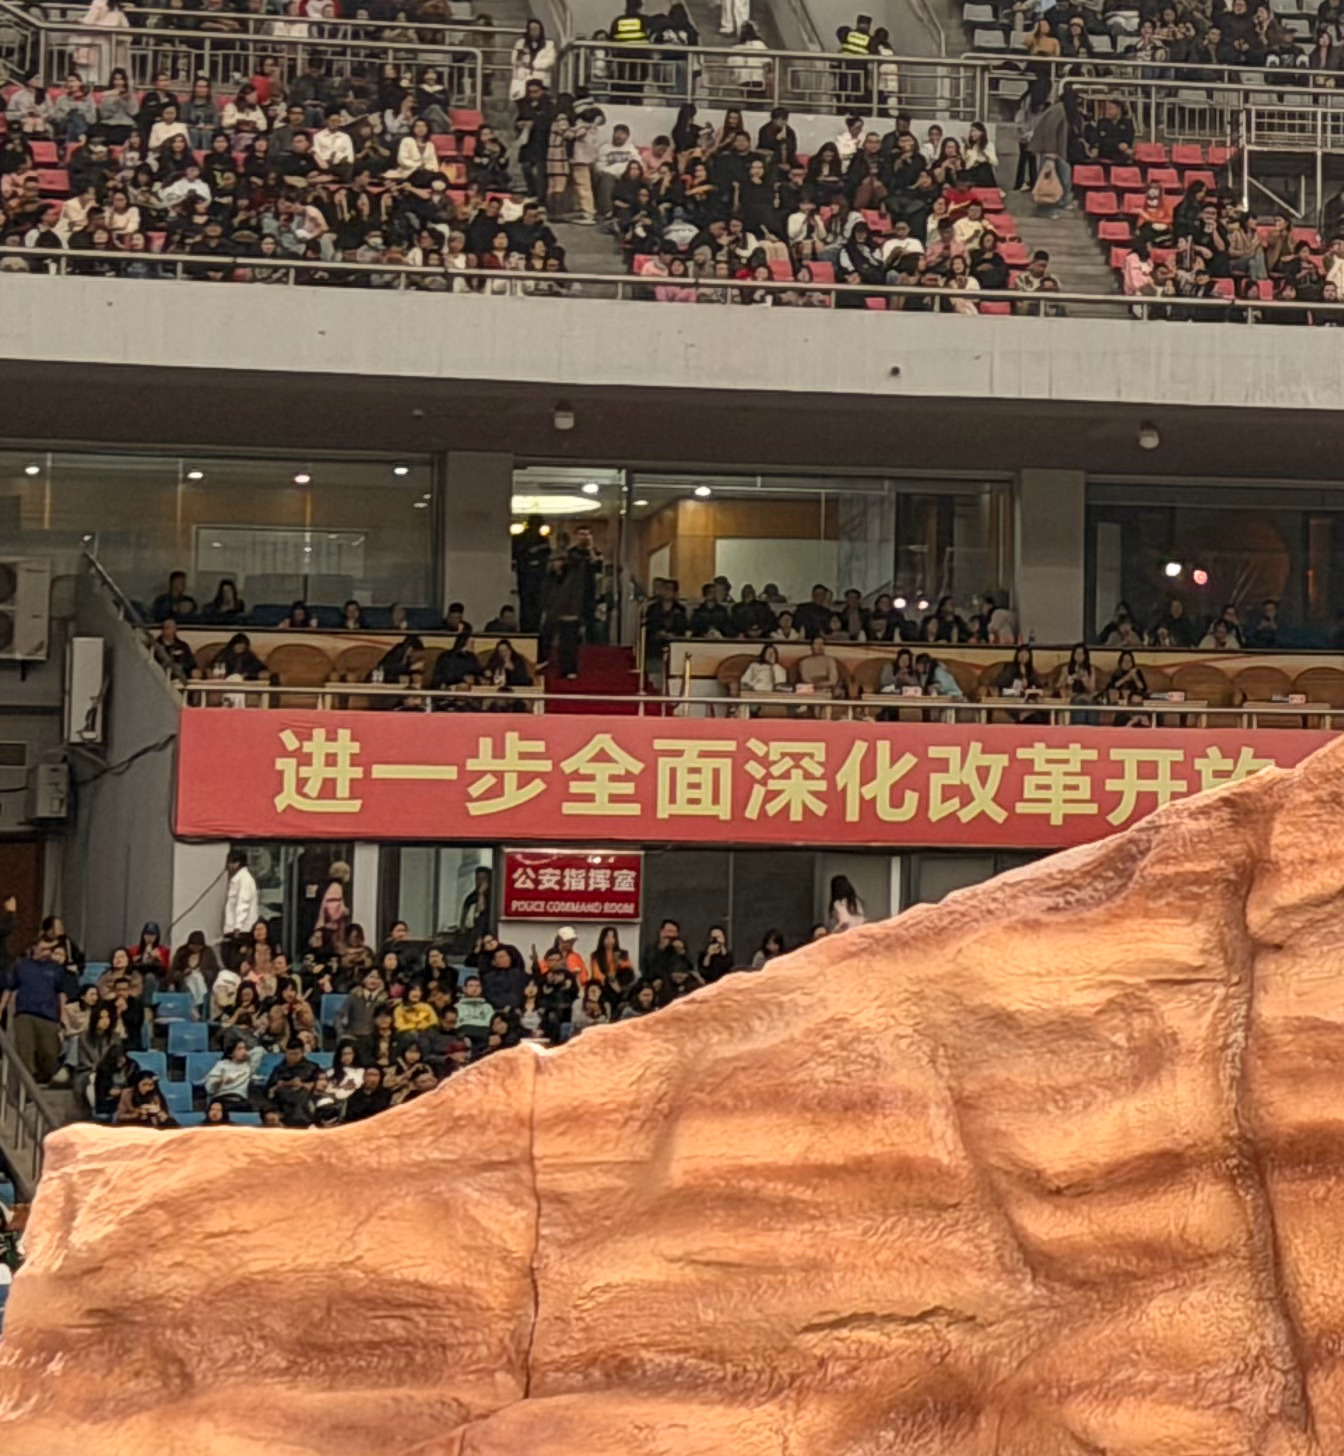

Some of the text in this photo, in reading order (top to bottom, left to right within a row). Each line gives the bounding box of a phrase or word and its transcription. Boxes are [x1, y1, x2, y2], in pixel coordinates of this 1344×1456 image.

[512, 867, 637, 892] 公安指挥室
